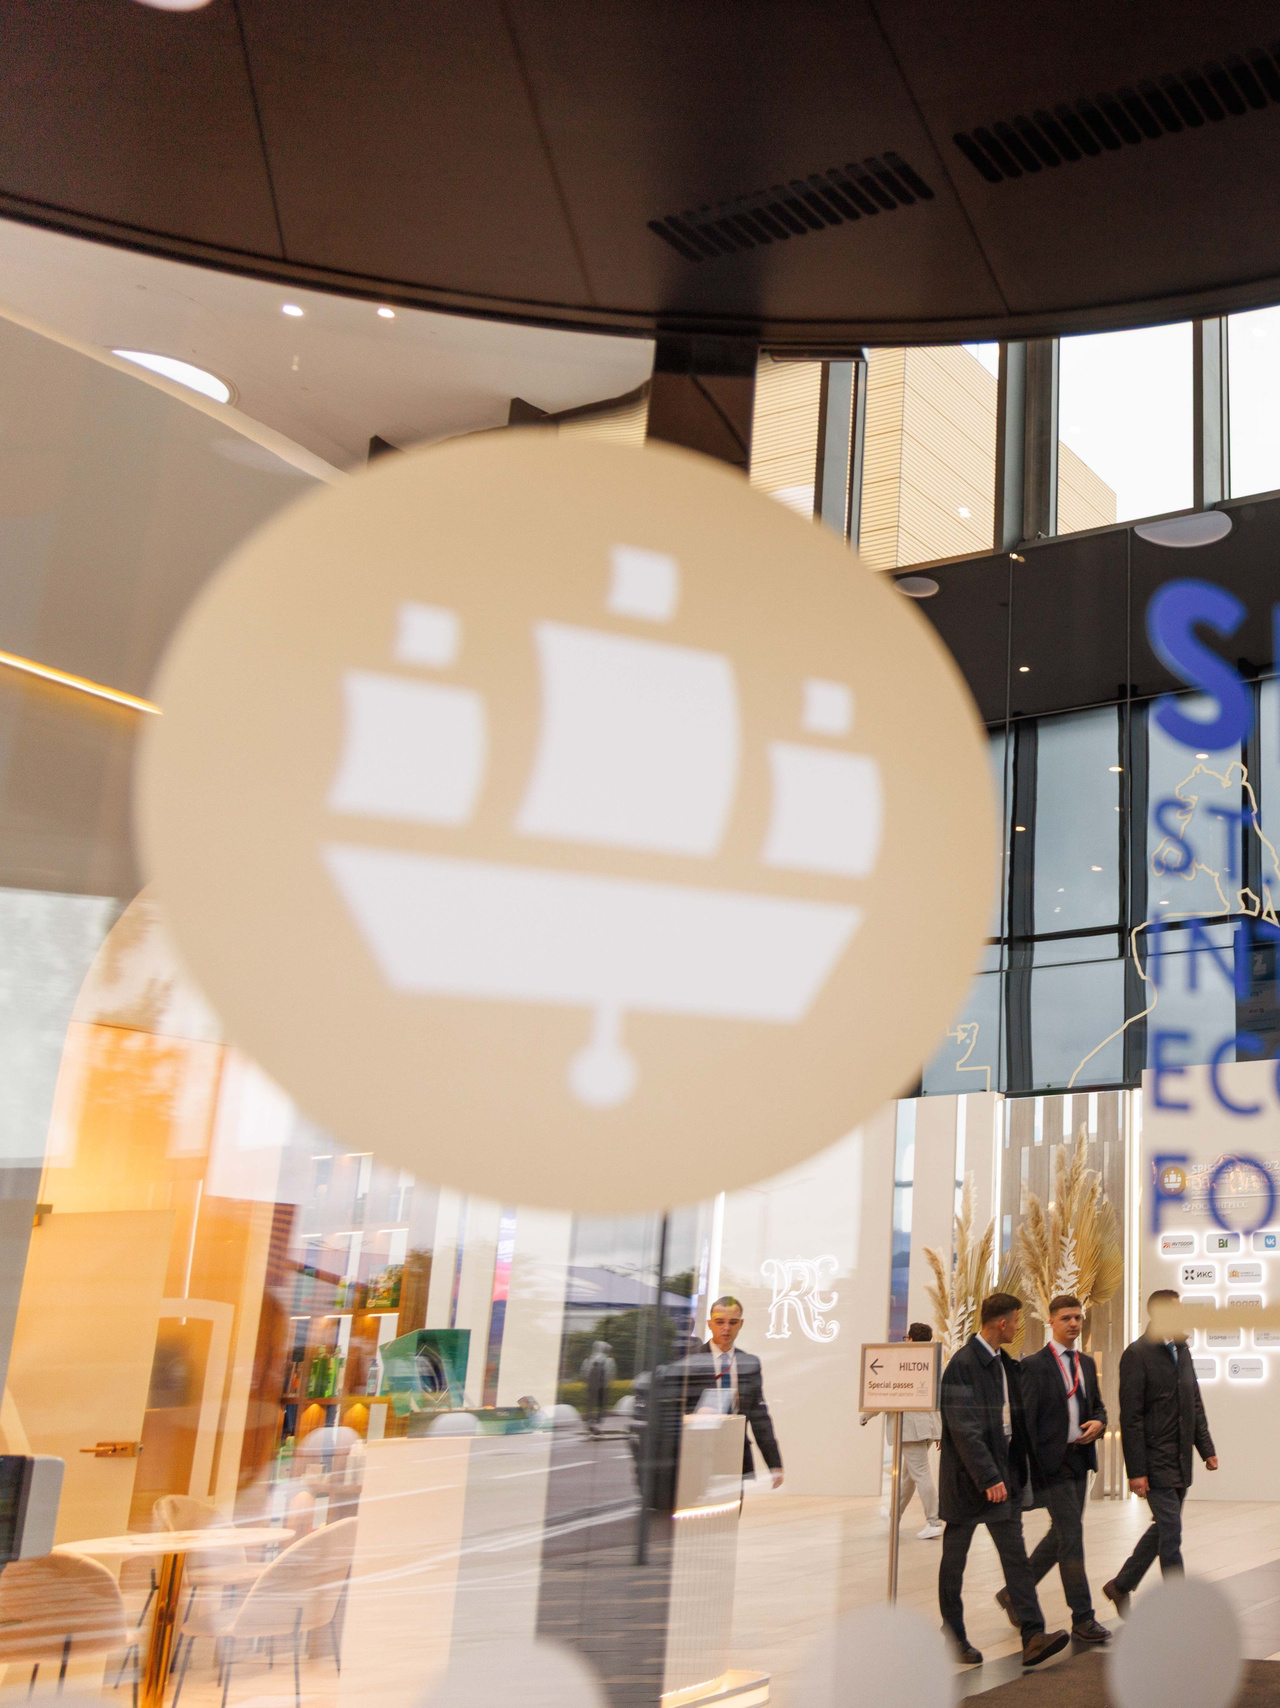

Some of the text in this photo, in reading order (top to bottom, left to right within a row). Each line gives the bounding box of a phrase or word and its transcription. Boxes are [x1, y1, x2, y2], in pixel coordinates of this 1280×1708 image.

[899, 1362, 929, 1372] HILTON
[868, 1381, 914, 1390] Special passes
